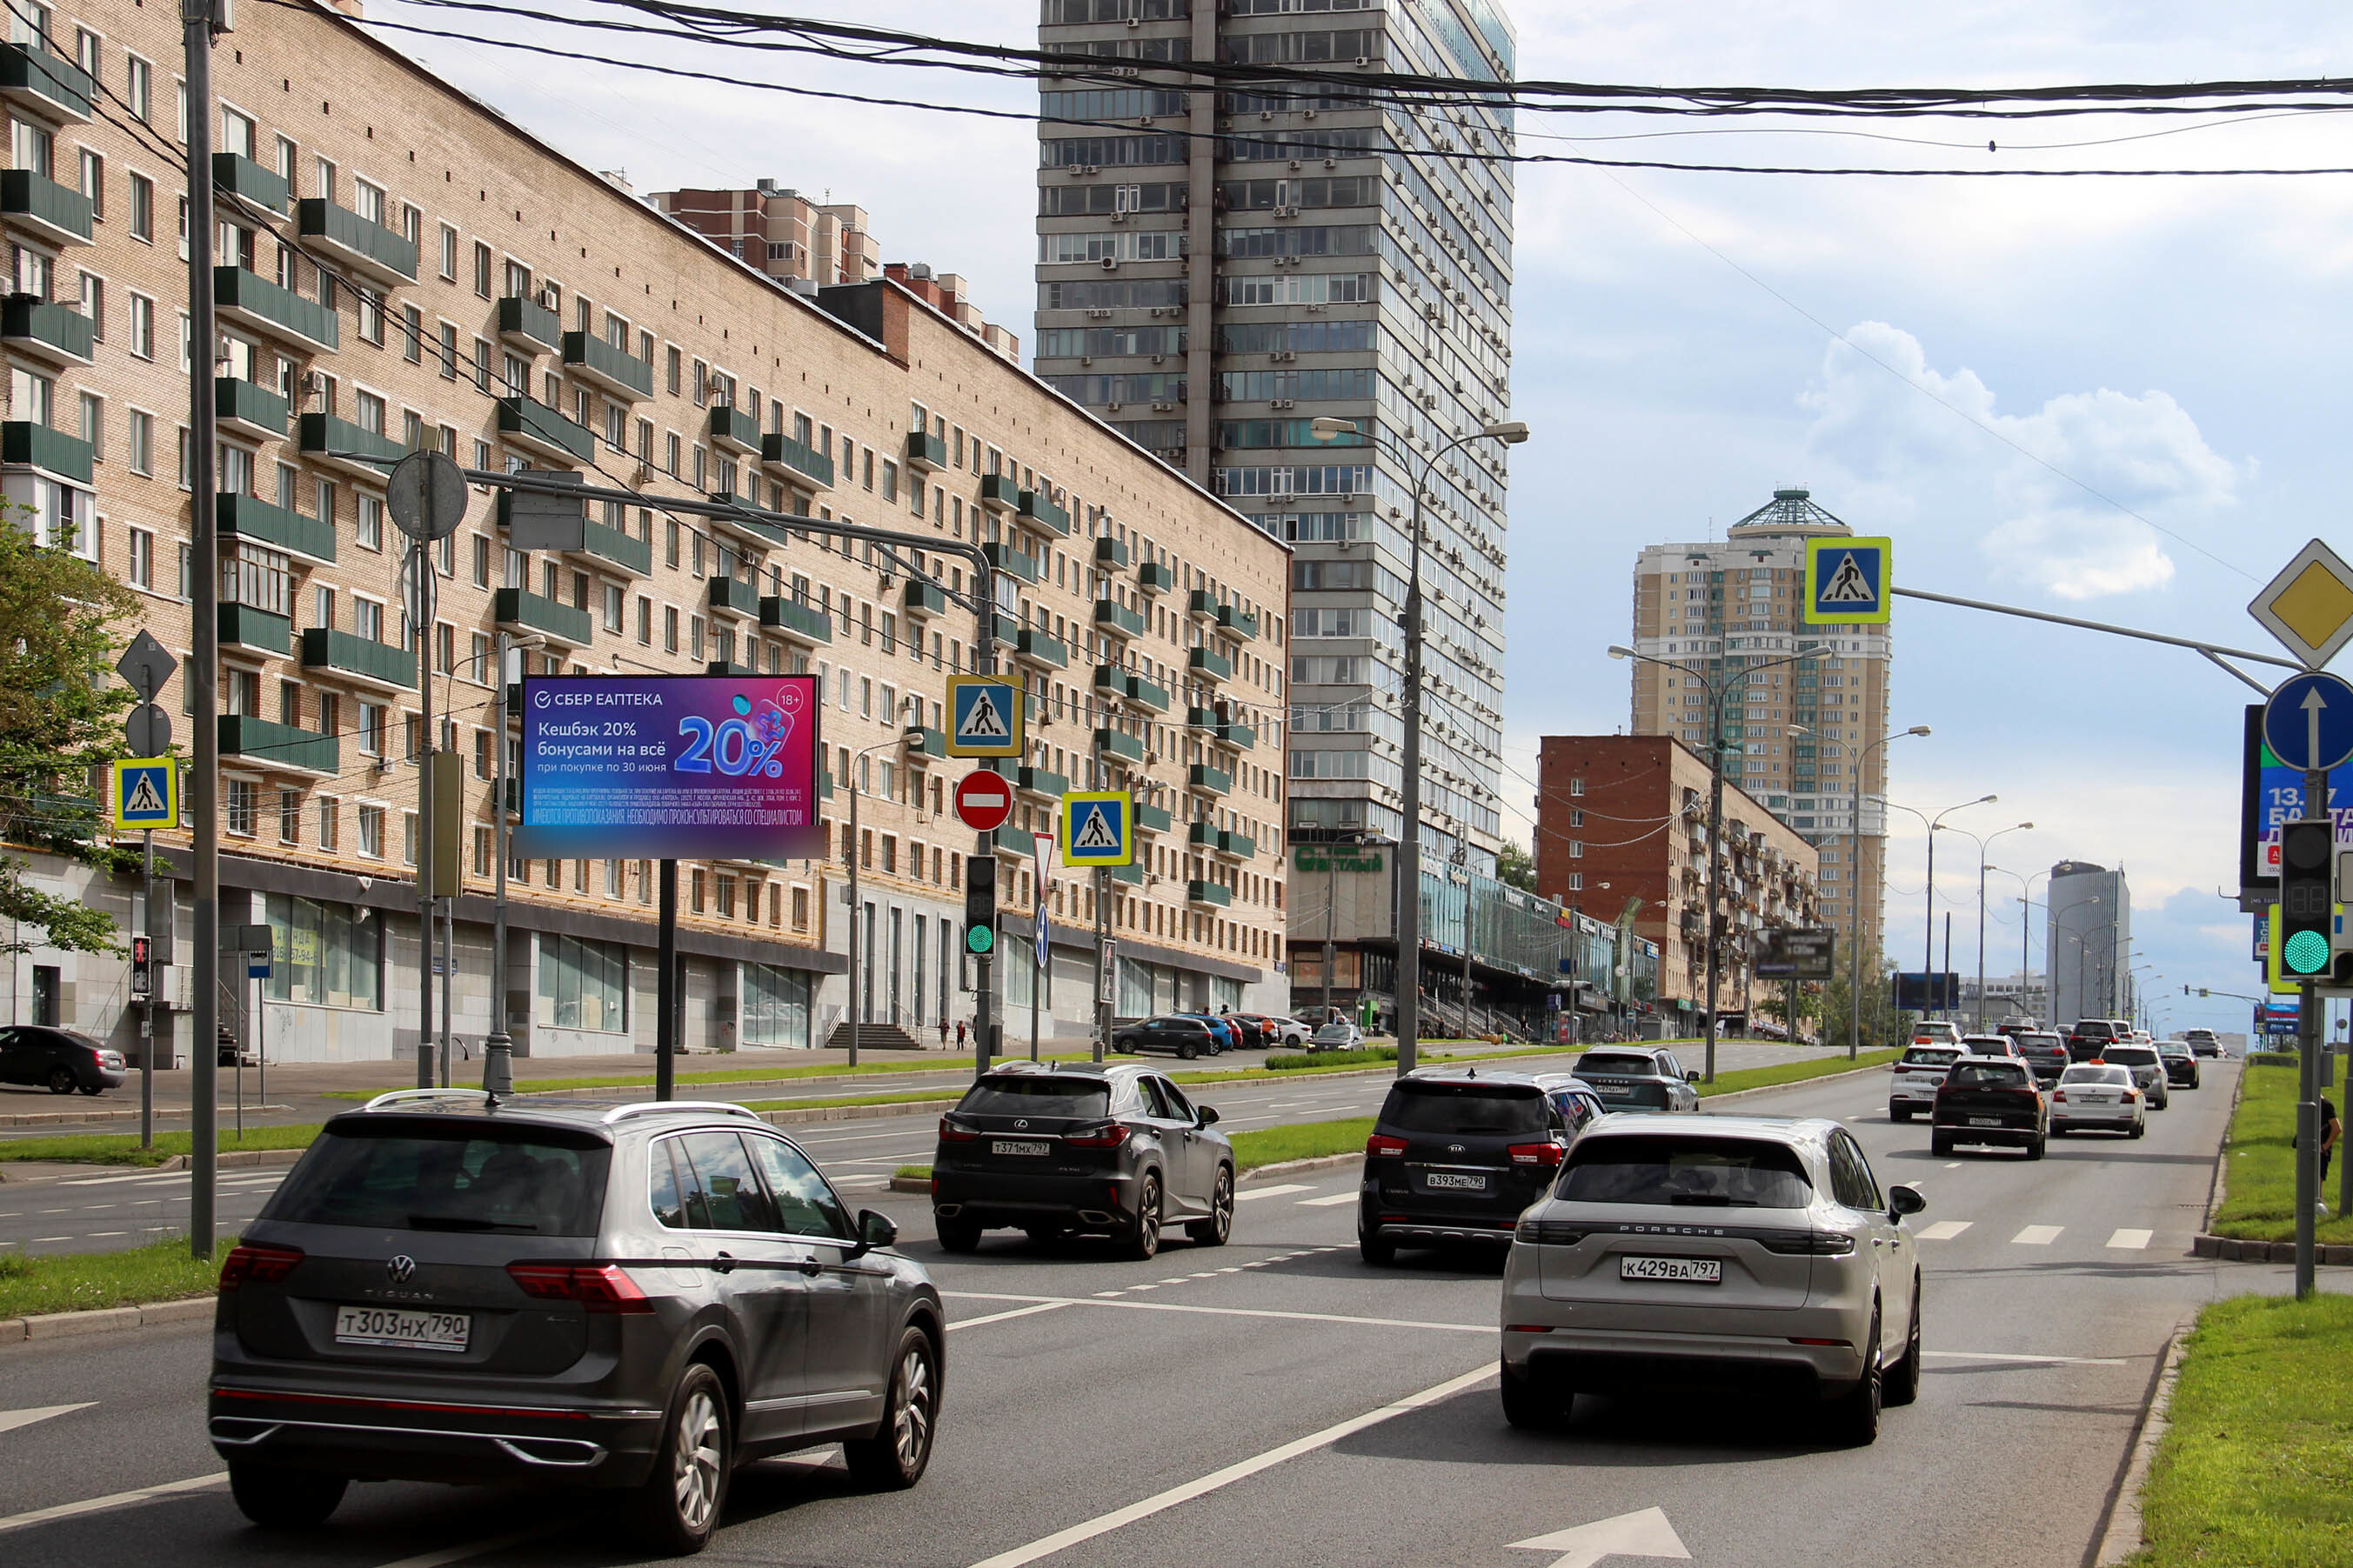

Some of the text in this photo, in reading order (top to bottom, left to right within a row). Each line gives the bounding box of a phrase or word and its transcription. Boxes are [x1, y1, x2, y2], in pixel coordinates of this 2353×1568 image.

[555, 693, 663, 705] СБЕР ЕАПТЕКА
[781, 695, 800, 705] 18+
[538, 722, 637, 736] Кешбэк 20%
[538, 741, 666, 758] бонусами на всё
[674, 716, 784, 778] 20%
[538, 762, 666, 773] при покупке по 30 июня
[2269, 787, 2337, 806] 13.7
[627, 808, 668, 825] НЕОБХОДИМО
[669, 808, 745, 825] ПРОКОНСУЛЬТИРОВАТЬСЯ
[745, 809, 752, 825] СО
[753, 809, 802, 825] СПЕЦИАЛИСТОМ
[2269, 807, 2353, 825] БАТА
[1620, 1225, 1723, 1235] PORSCHE
[1692, 1261, 1716, 1276] 797
[365, 1289, 434, 1300] TIGUAN
[431, 1315, 465, 1334] 790
